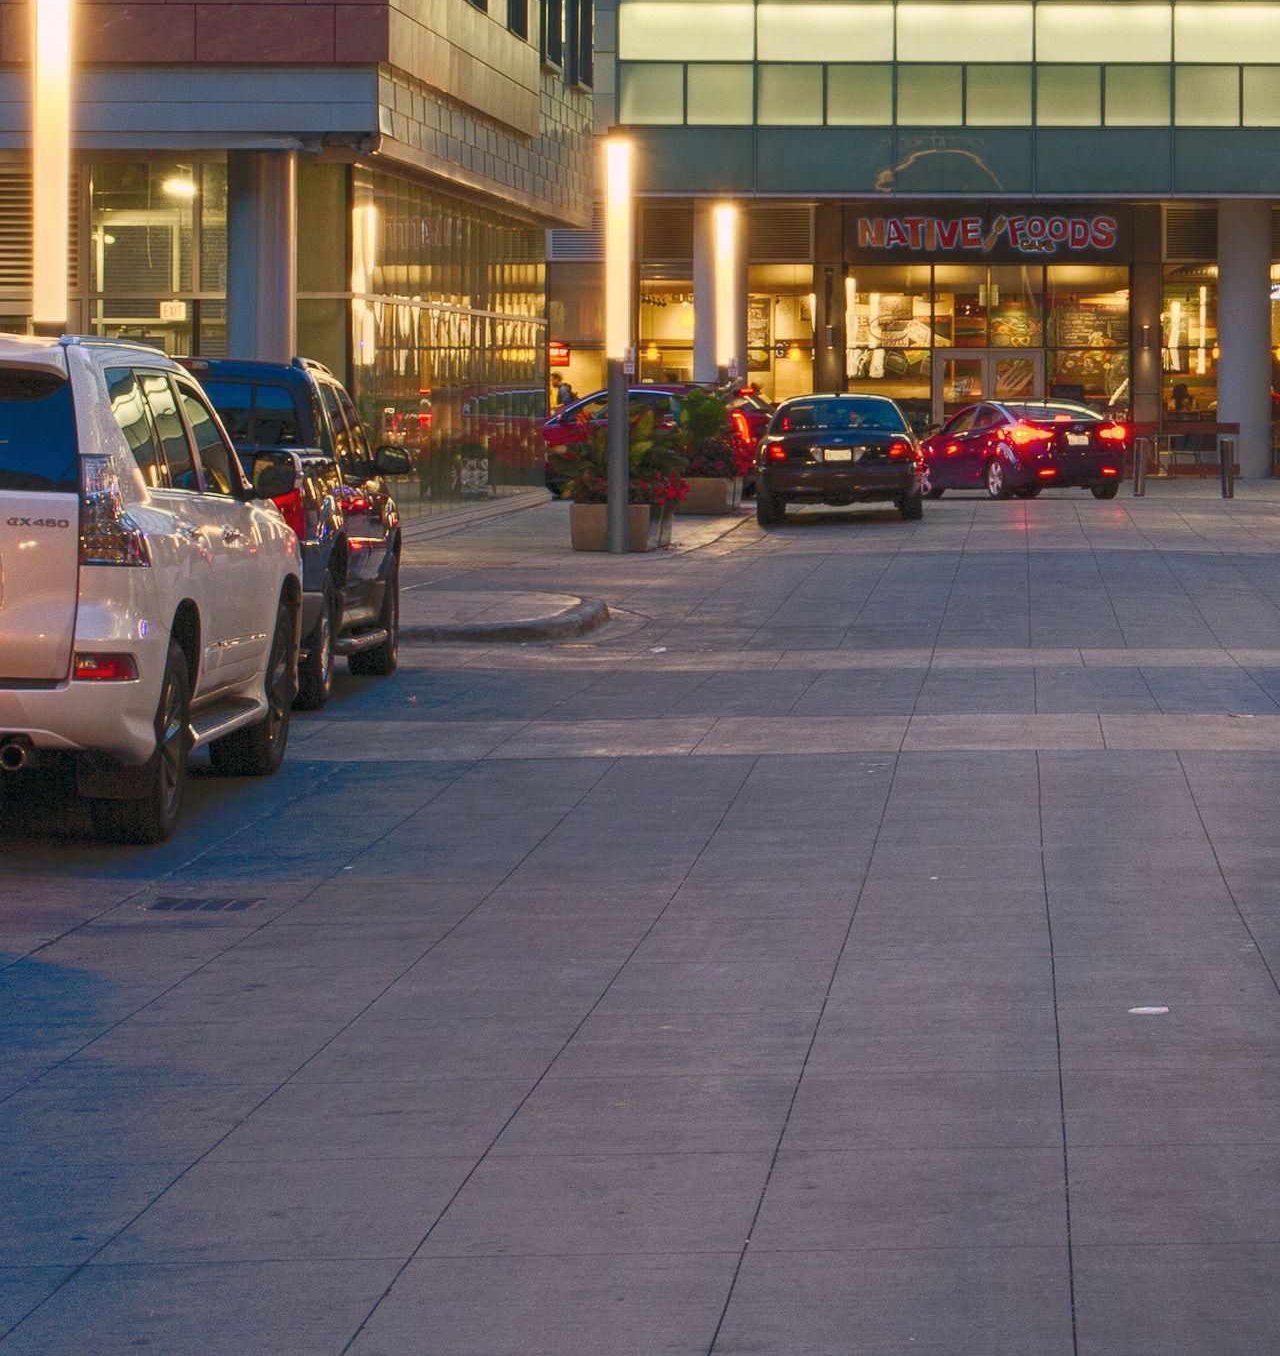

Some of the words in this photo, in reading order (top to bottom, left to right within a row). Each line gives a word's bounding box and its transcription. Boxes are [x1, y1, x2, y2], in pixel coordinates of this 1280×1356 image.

[858, 217, 982, 250] NATIVE
[1008, 216, 1117, 248] FOODS
[163, 304, 182, 317] EXIT
